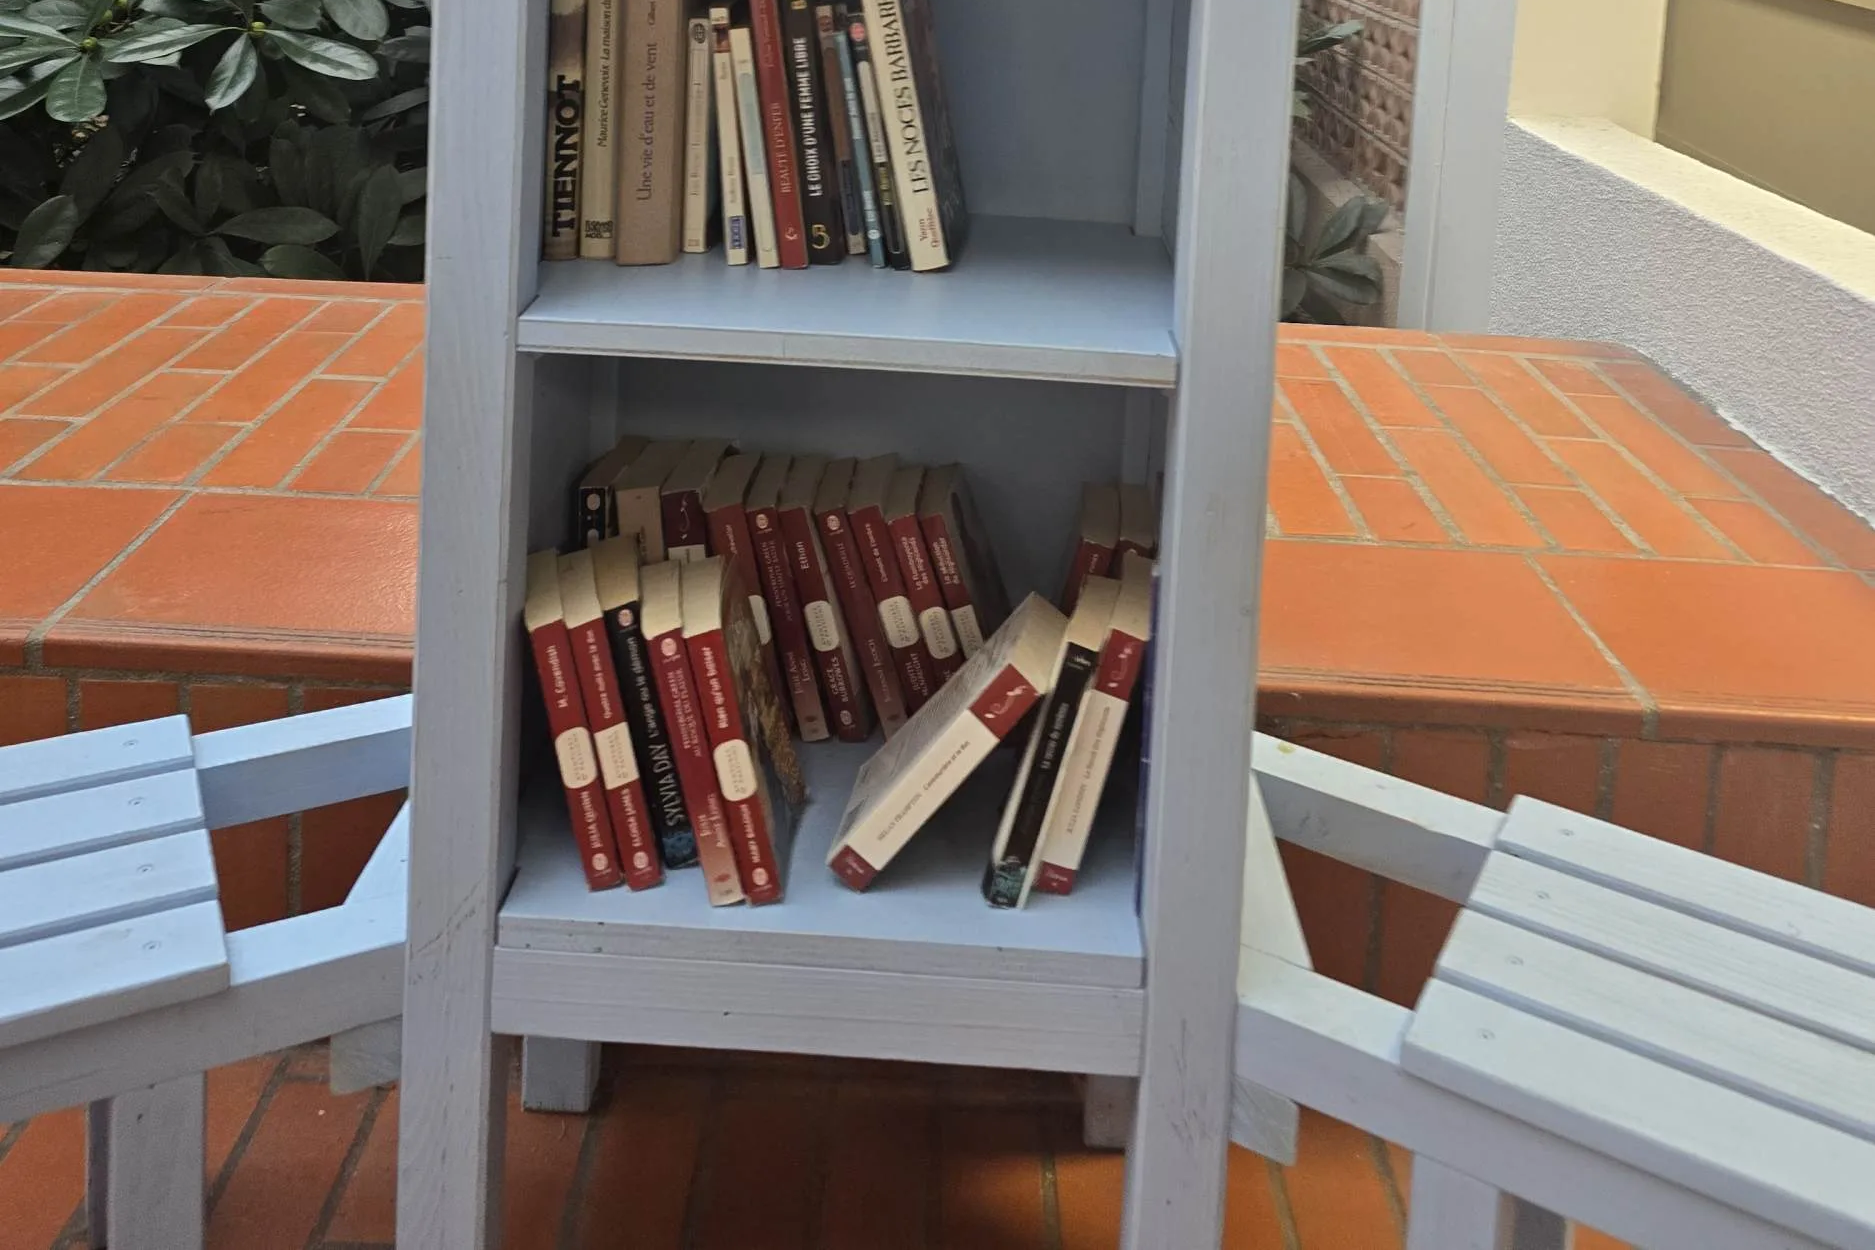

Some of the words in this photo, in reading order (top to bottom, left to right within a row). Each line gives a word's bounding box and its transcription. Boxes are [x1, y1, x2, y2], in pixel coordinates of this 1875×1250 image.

[601, 10, 611, 46] maison
[599, 47, 610, 60] La
[646, 42, 657, 70] vent
[792, 36, 808, 68] LIBRE
[598, 64, 609, 108] Genevoix
[641, 74, 656, 90] de
[797, 70, 812, 109] FEMME
[643, 94, 655, 107] et
[597, 109, 607, 147] Maurice
[639, 110, 654, 146] d'eau
[801, 111, 816, 145] D'UNE
[893, 86, 921, 154] NOCES
[551, 76, 580, 235] TIENNOT
[639, 148, 651, 168] vie
[805, 146, 820, 181] CHOIX
[637, 171, 652, 201] Une
[808, 183, 823, 196] LE
[907, 158, 928, 194] LES
[796, 540, 808, 569] Ethan
[545, 644, 565, 693] Cavendish
[709, 676, 724, 706] qu'un
[716, 706, 728, 728] Rien
[648, 741, 670, 773] DAY
[656, 773, 683, 825] SYLVIA
